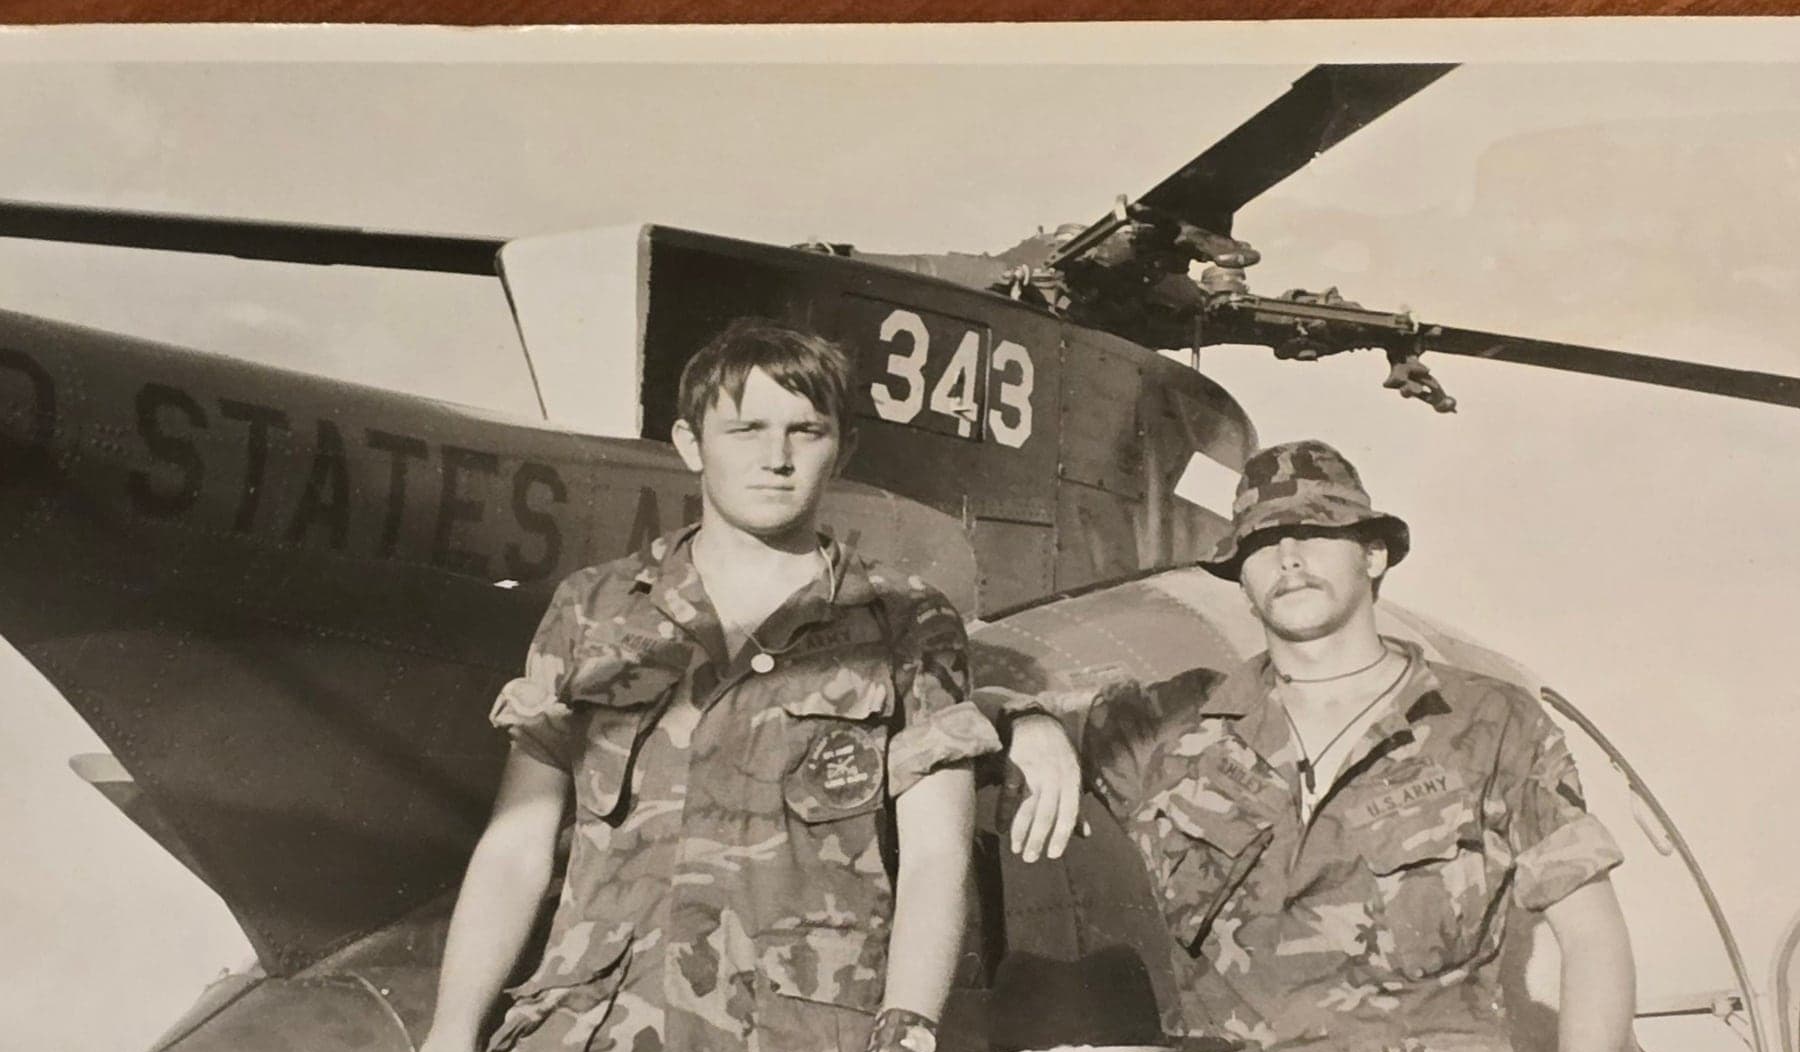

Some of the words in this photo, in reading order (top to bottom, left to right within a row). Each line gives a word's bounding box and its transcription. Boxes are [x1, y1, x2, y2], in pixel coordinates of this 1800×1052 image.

[870, 309, 1034, 449] 343
[125, 381, 568, 583] STATES
[1402, 775, 1447, 803] ARMY
